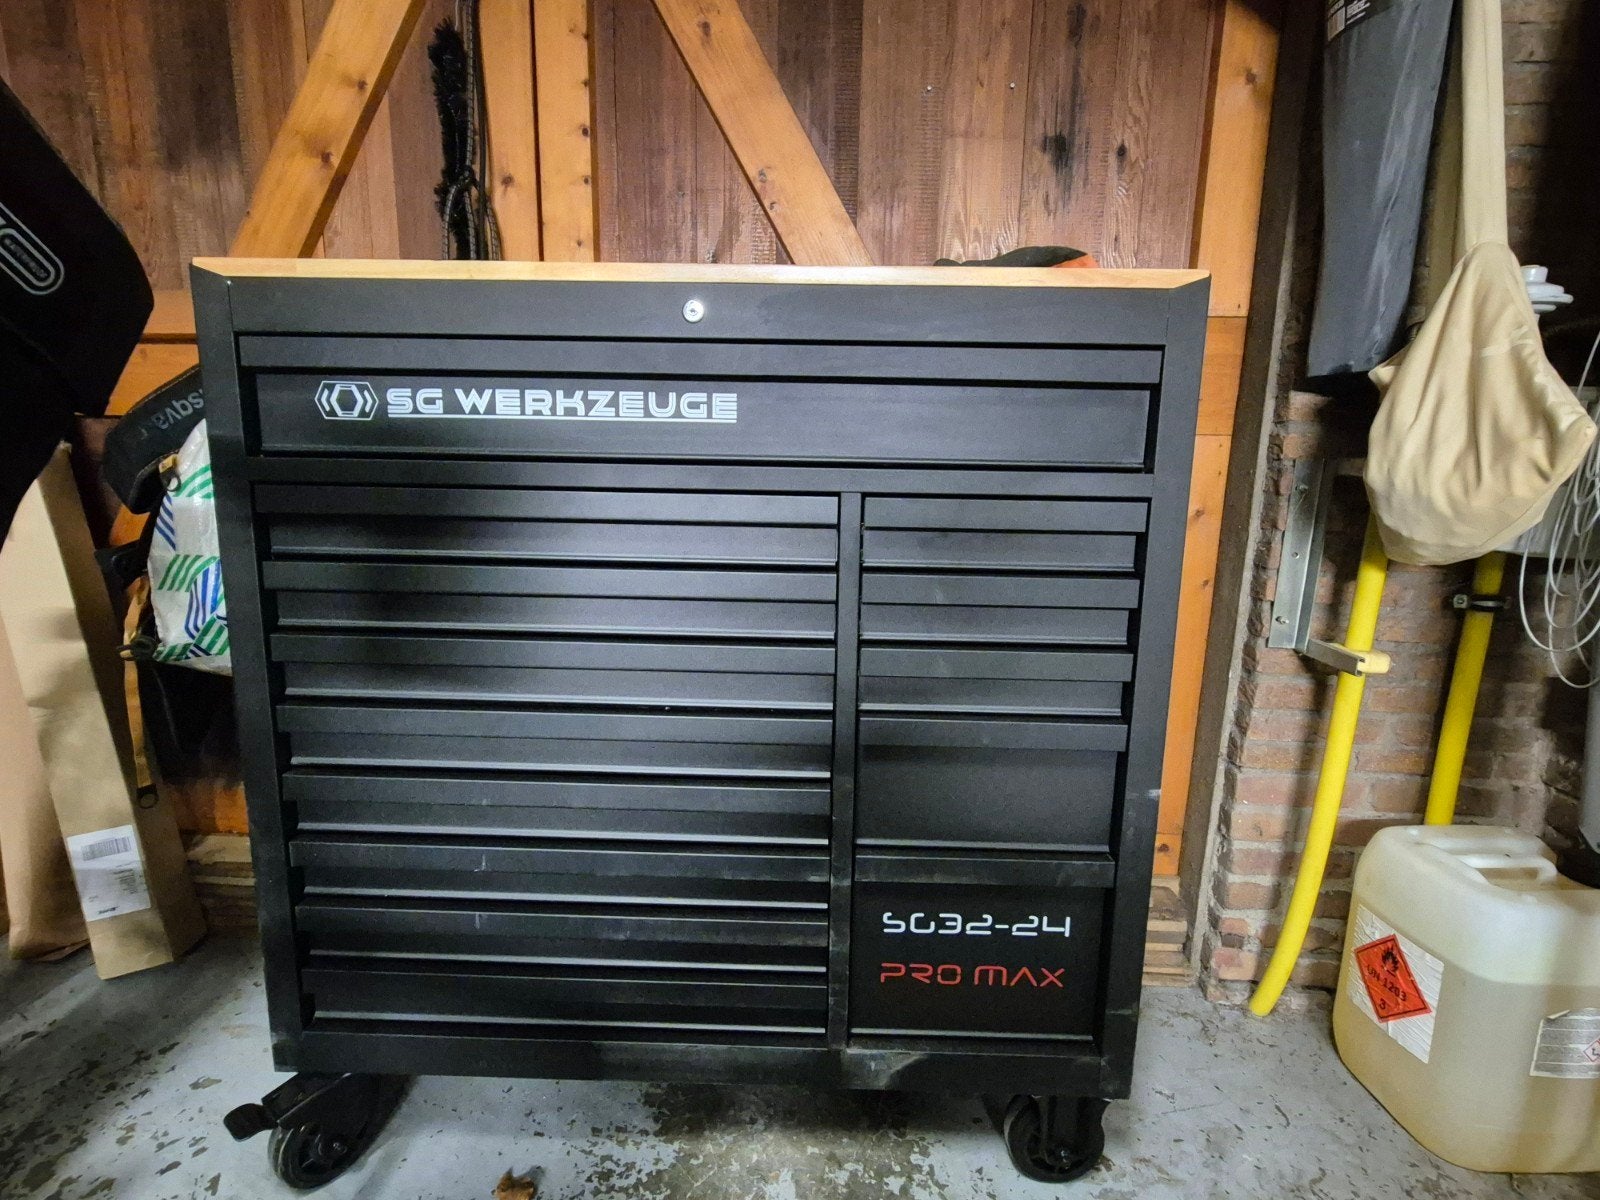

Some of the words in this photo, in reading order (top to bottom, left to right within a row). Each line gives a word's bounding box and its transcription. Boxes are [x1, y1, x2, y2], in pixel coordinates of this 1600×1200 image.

[387, 388, 443, 415] SG
[454, 388, 738, 418] WERKZEUGE
[882, 912, 1071, 938] SG32-24
[880, 962, 962, 985] PRO
[974, 965, 1065, 988] MAX
[1383, 977, 1407, 1002] 1203
[1379, 998, 1387, 1010] 3
